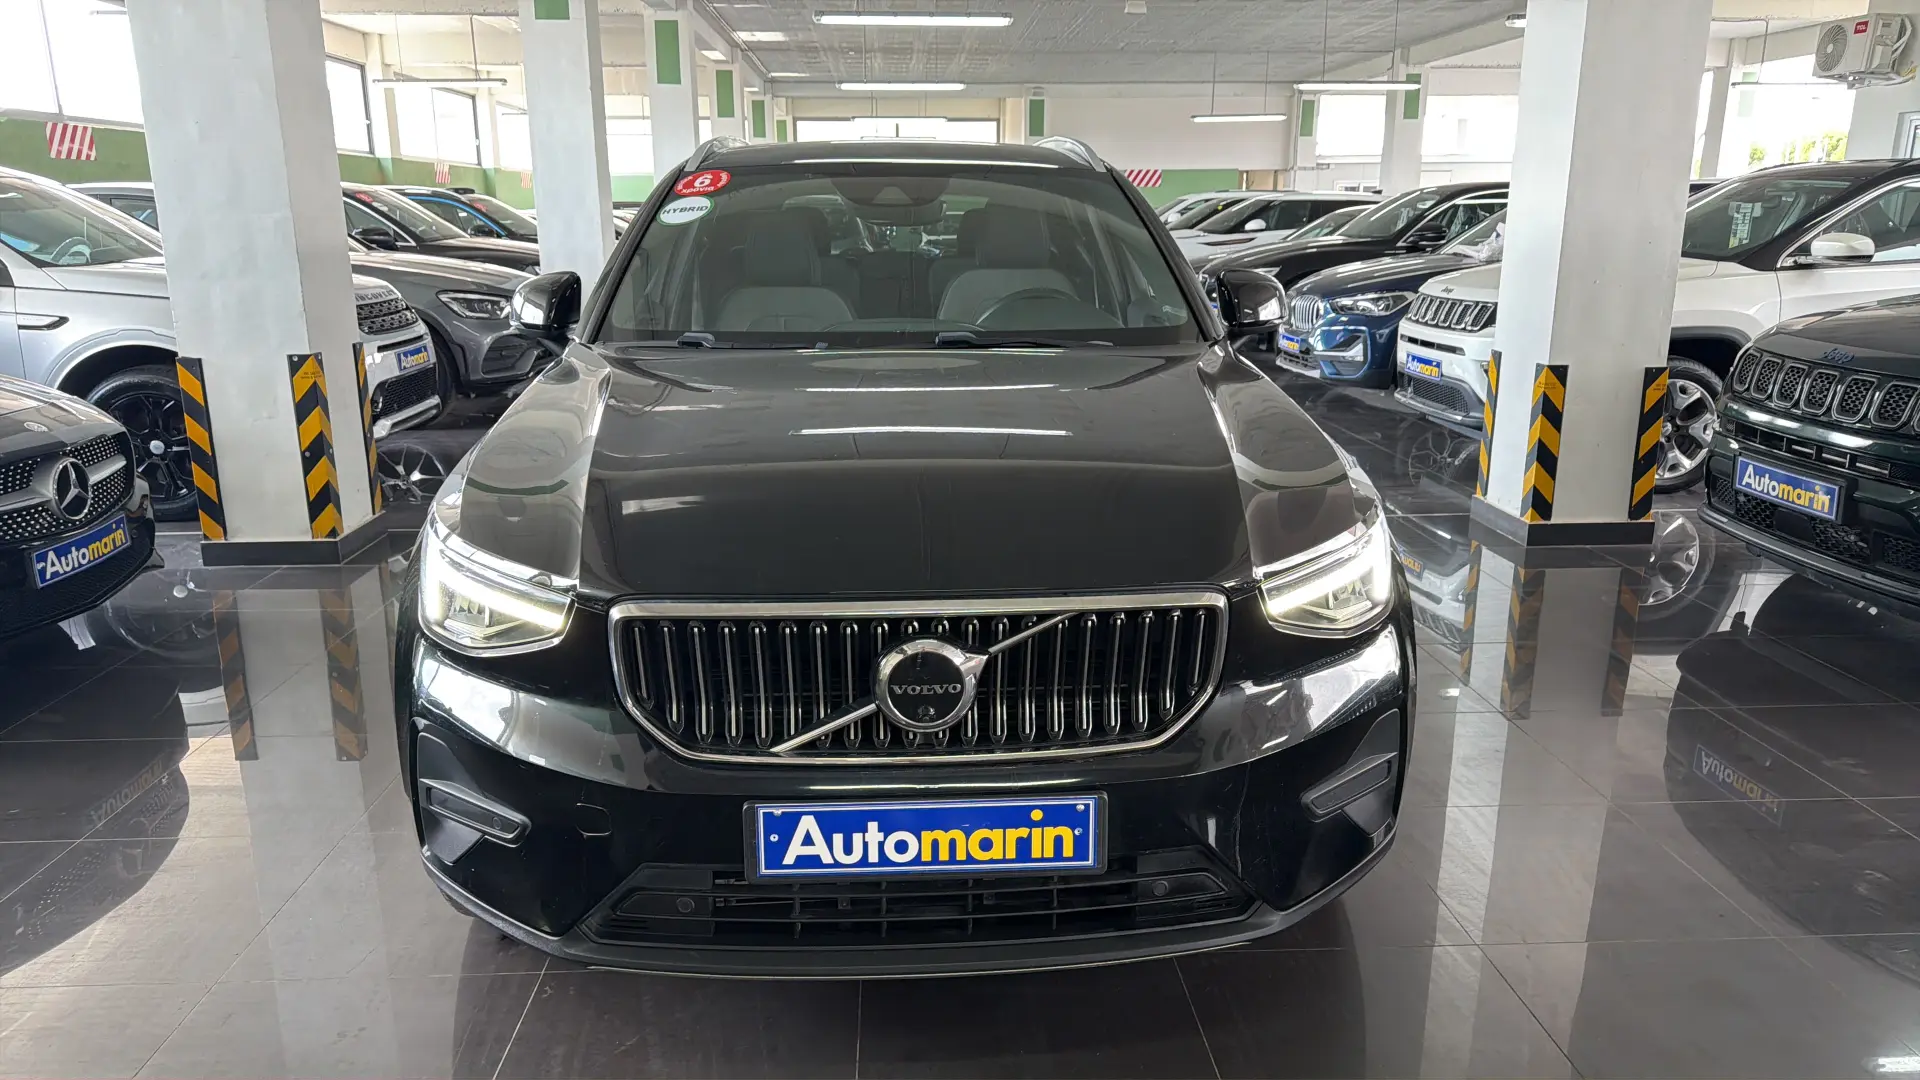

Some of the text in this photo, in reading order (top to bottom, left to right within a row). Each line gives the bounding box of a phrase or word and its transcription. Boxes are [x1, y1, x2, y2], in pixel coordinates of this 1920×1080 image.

[694, 173, 713, 187] 6
[661, 205, 709, 215] HYBRID
[400, 347, 428, 369] Automarin
[1406, 354, 1439, 377] Automarin
[1741, 464, 1831, 513] Automarin
[45, 523, 126, 580] Automarin
[890, 683, 962, 695] VOLVO
[782, 809, 1075, 865] Automarin
